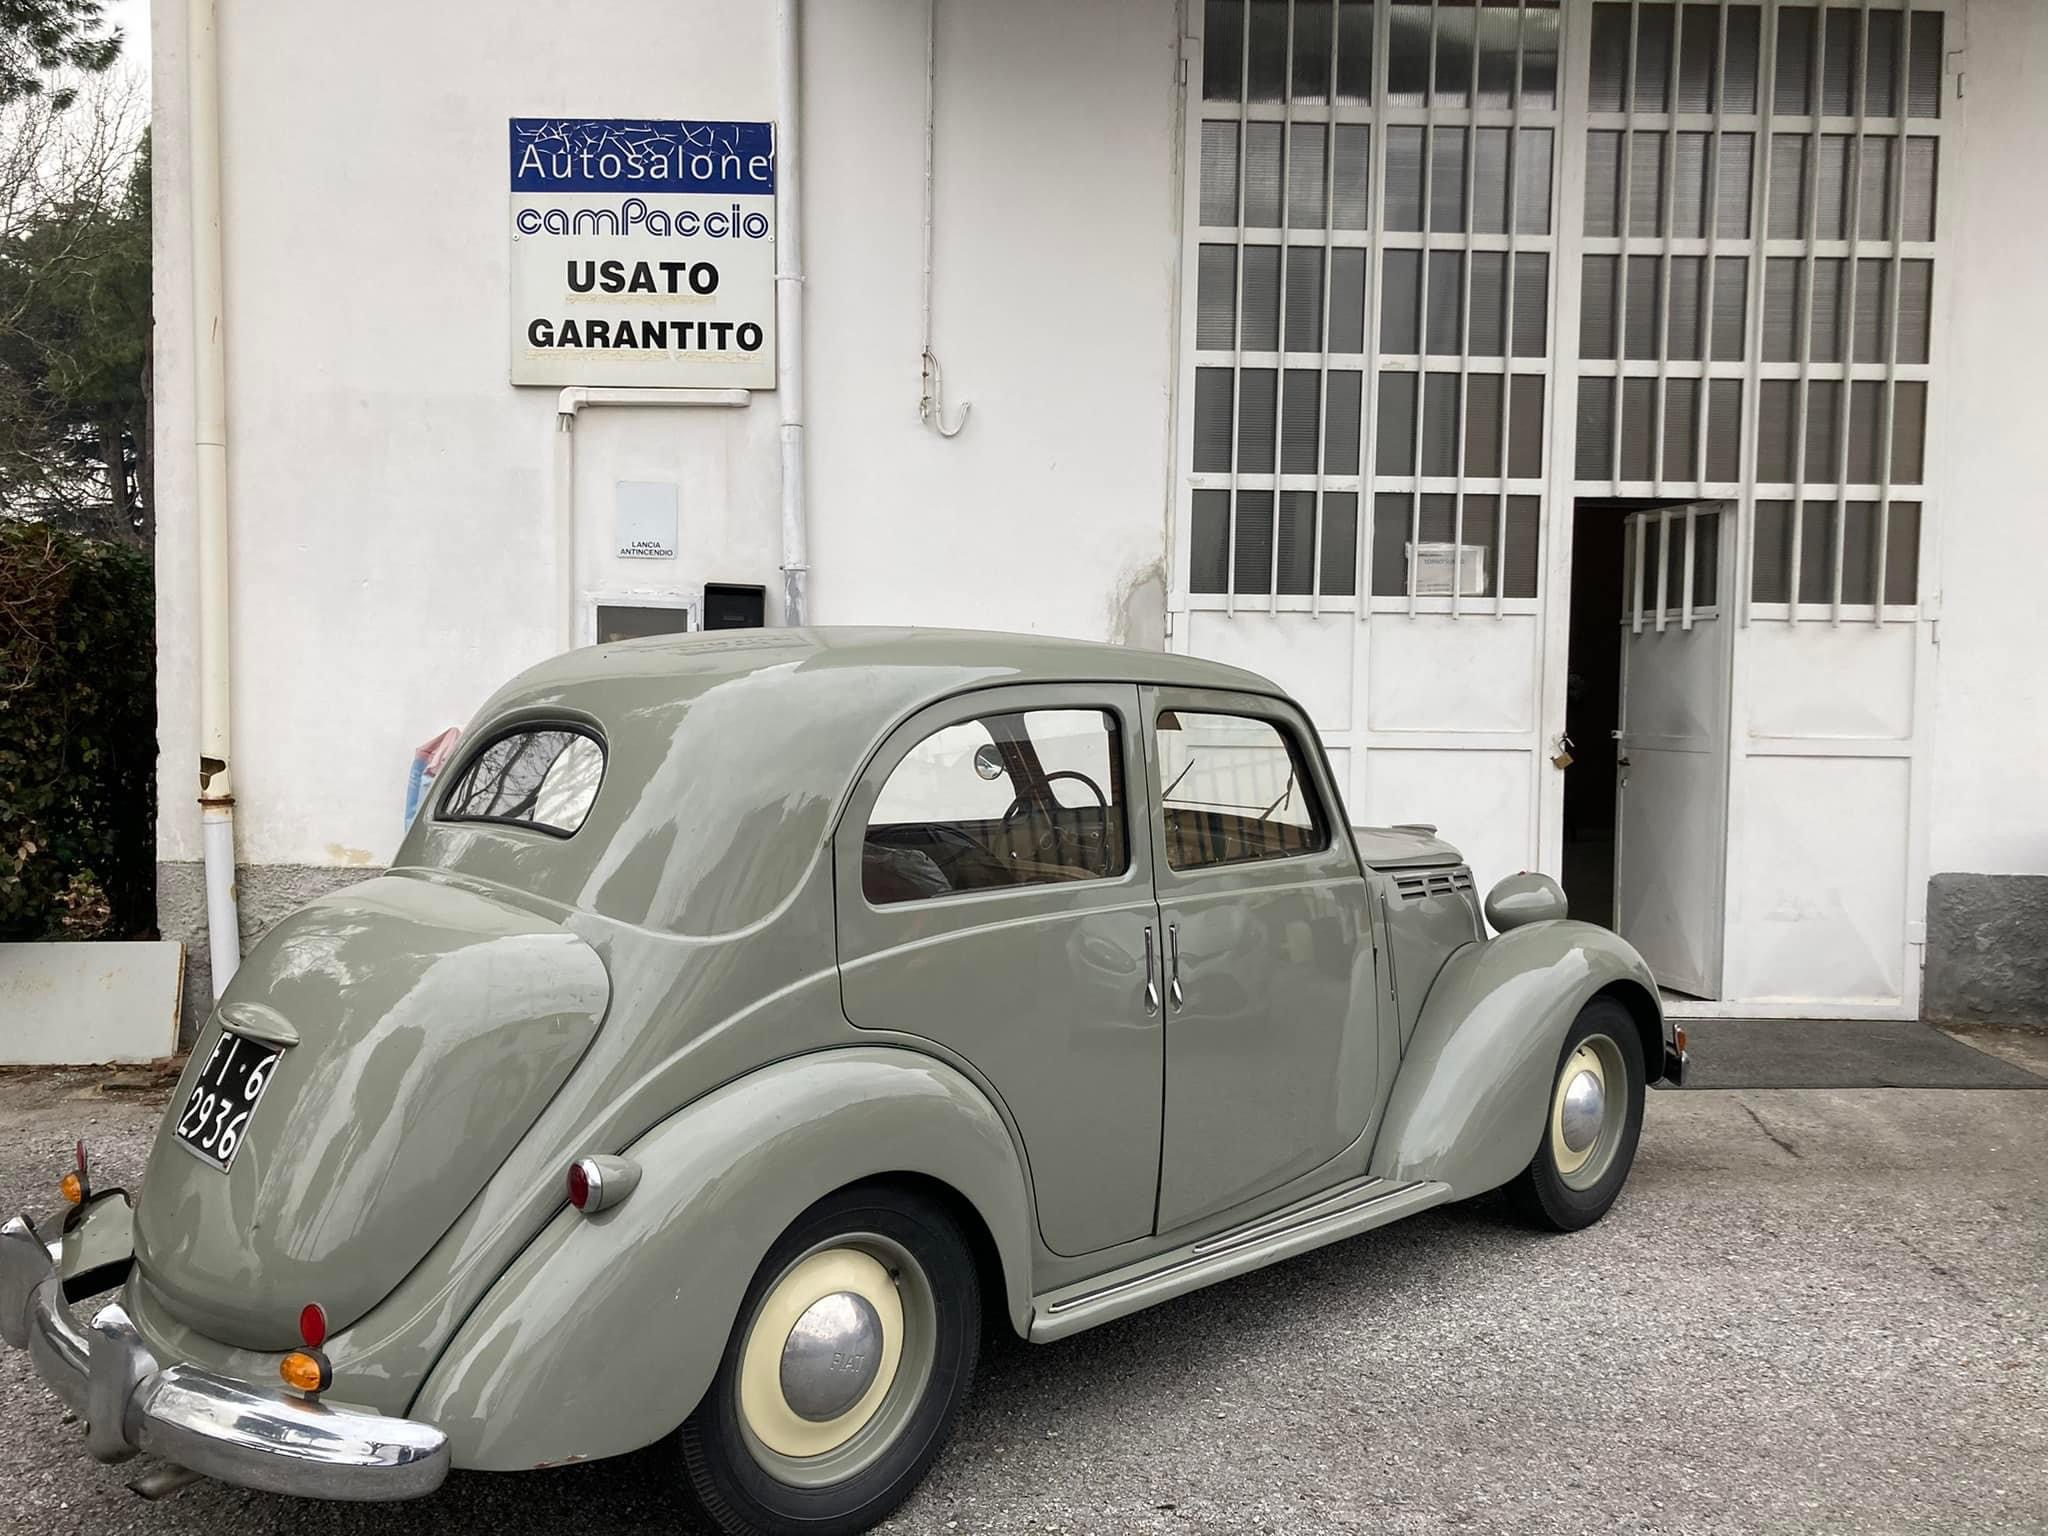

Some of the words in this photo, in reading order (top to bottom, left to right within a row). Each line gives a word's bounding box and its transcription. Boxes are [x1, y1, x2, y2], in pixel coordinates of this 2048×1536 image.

[518, 144, 768, 181] Autosalone
[567, 260, 719, 294] USATO
[527, 318, 763, 351] GARANTITO
[620, 548, 673, 556] ANTINCENDIO
[631, 541, 661, 549] LANCIA
[178, 1085, 249, 1159] 2936
[829, 1352, 865, 1373] FIAT
